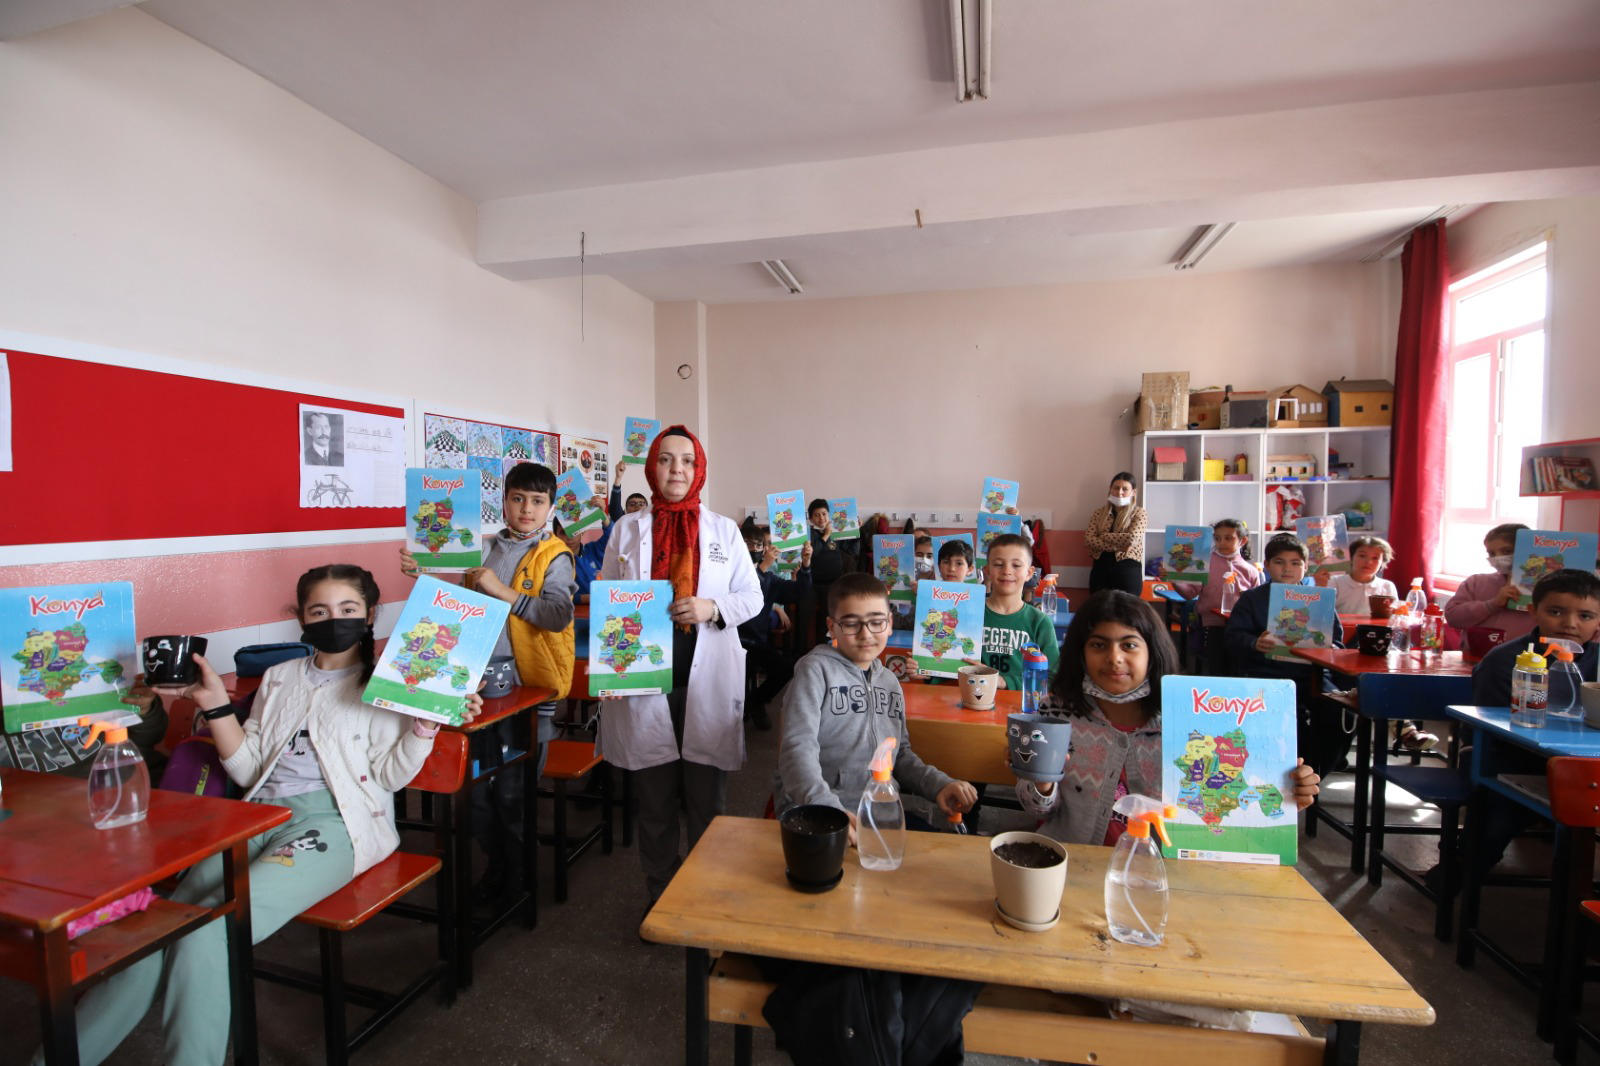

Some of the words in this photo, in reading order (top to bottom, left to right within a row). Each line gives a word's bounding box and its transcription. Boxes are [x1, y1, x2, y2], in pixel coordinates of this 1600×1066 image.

[423, 475, 464, 496] Konya
[1533, 534, 1579, 554] Konya
[29, 591, 105, 620] Konya
[432, 588, 487, 622] Konya
[609, 587, 655, 609] Konya
[932, 586, 970, 606] Konya
[1284, 589, 1320, 606] Konya
[986, 645, 1015, 656] LEAGUE
[1192, 687, 1266, 726] Konya
